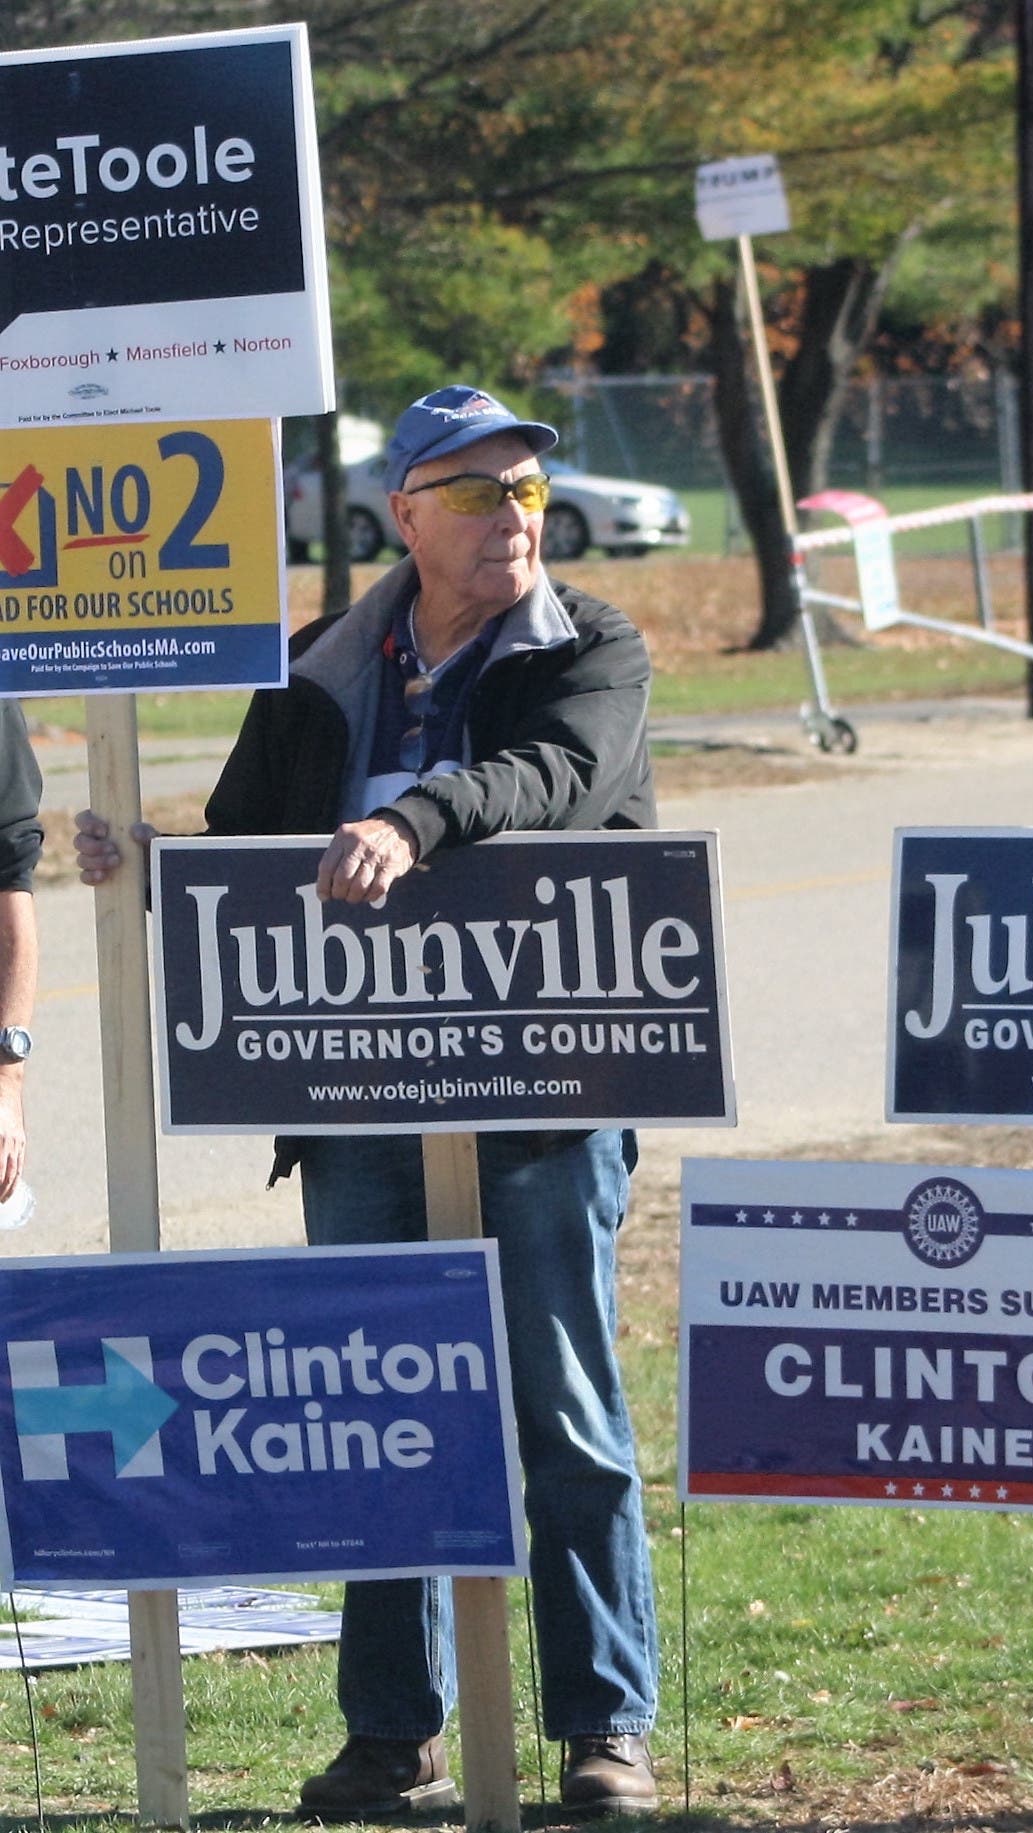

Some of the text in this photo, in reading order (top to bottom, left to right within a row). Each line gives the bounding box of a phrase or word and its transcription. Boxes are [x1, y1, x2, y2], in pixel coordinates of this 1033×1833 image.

[0, 203, 260, 255] Representative
[0, 335, 292, 371] Foxborough Mansfield Norton
[66, 430, 231, 571] NO 2
[109, 550, 147, 580] on
[27, 594, 69, 621] FOR
[74, 592, 122, 619] OUR
[128, 588, 234, 618] SCHOOLS
[0, 638, 216, 662] aveOurPublicSchoolsMA.com
[175, 875, 700, 1051] Jubinville
[236, 1022, 707, 1061] GOVERNOR'S COUNCIL
[308, 1075, 582, 1103] www.votejubinville.com
[927, 1213, 961, 1233] UAW
[719, 1280, 800, 1309] UAW
[812, 1283, 989, 1315] MEMBERS
[181, 1327, 488, 1401] Clinton
[193, 1401, 434, 1476] Kaine
